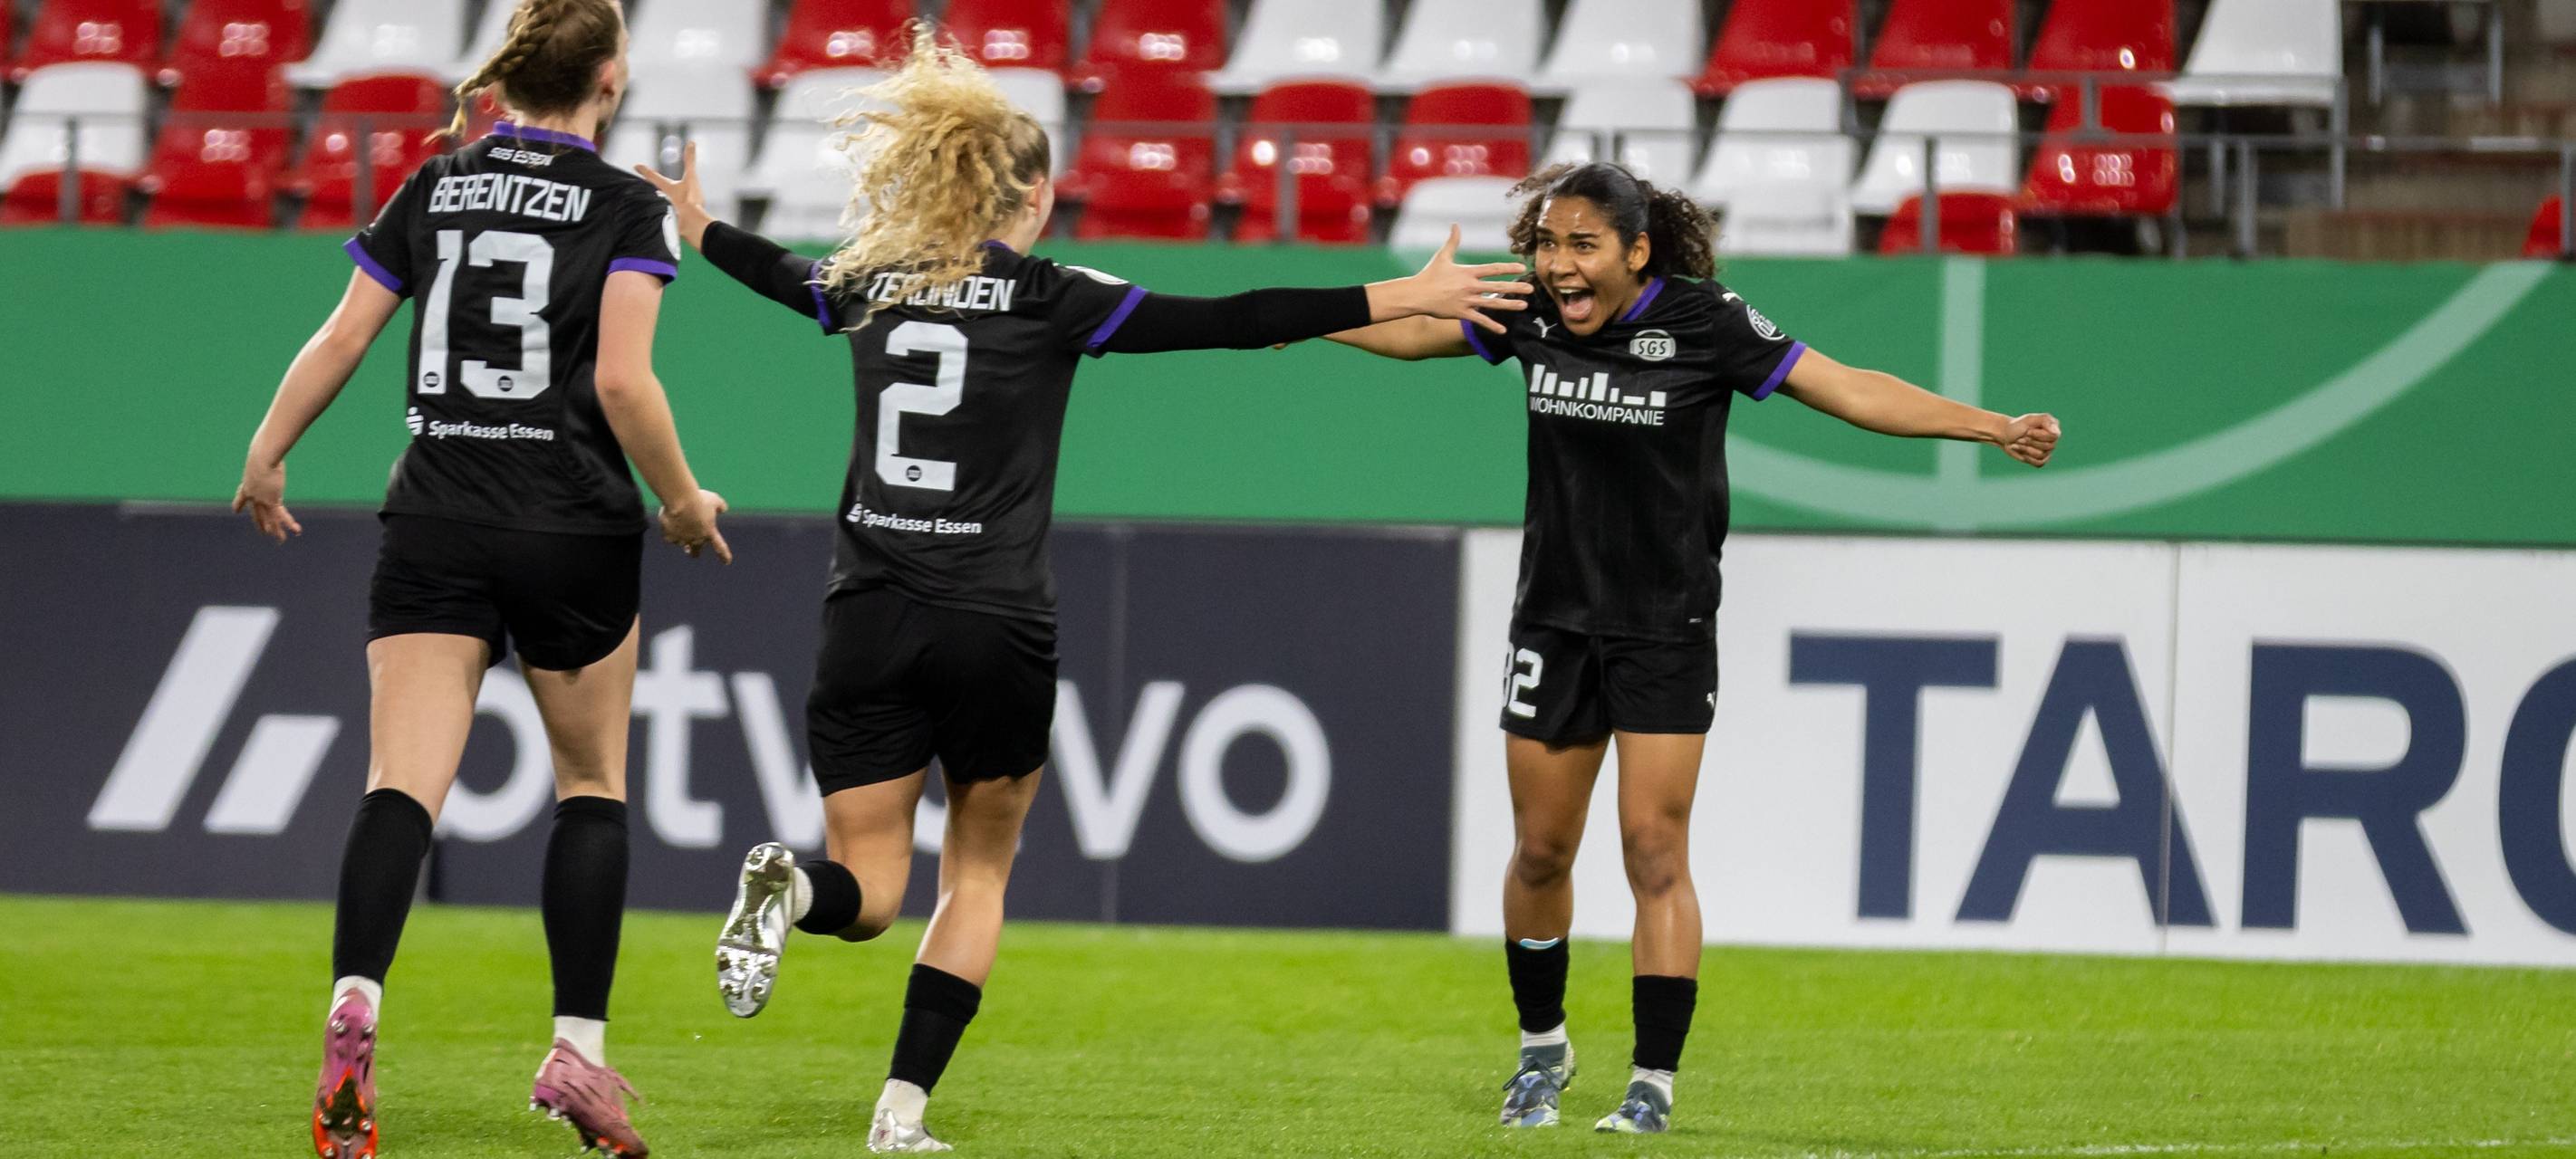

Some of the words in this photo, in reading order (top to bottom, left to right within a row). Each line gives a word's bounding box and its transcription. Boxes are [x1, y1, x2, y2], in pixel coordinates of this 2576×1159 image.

[428, 173, 591, 222] BERENTZEN
[418, 230, 554, 399] 13
[1639, 340, 1667, 355] SGS
[875, 321, 968, 491] 2
[1530, 397, 1665, 426] WOHNKOMPANIE
[428, 420, 508, 439] Sparkasse
[509, 424, 554, 441] Essen
[862, 509, 933, 532] Sparkasse
[935, 519, 982, 533] Essen
